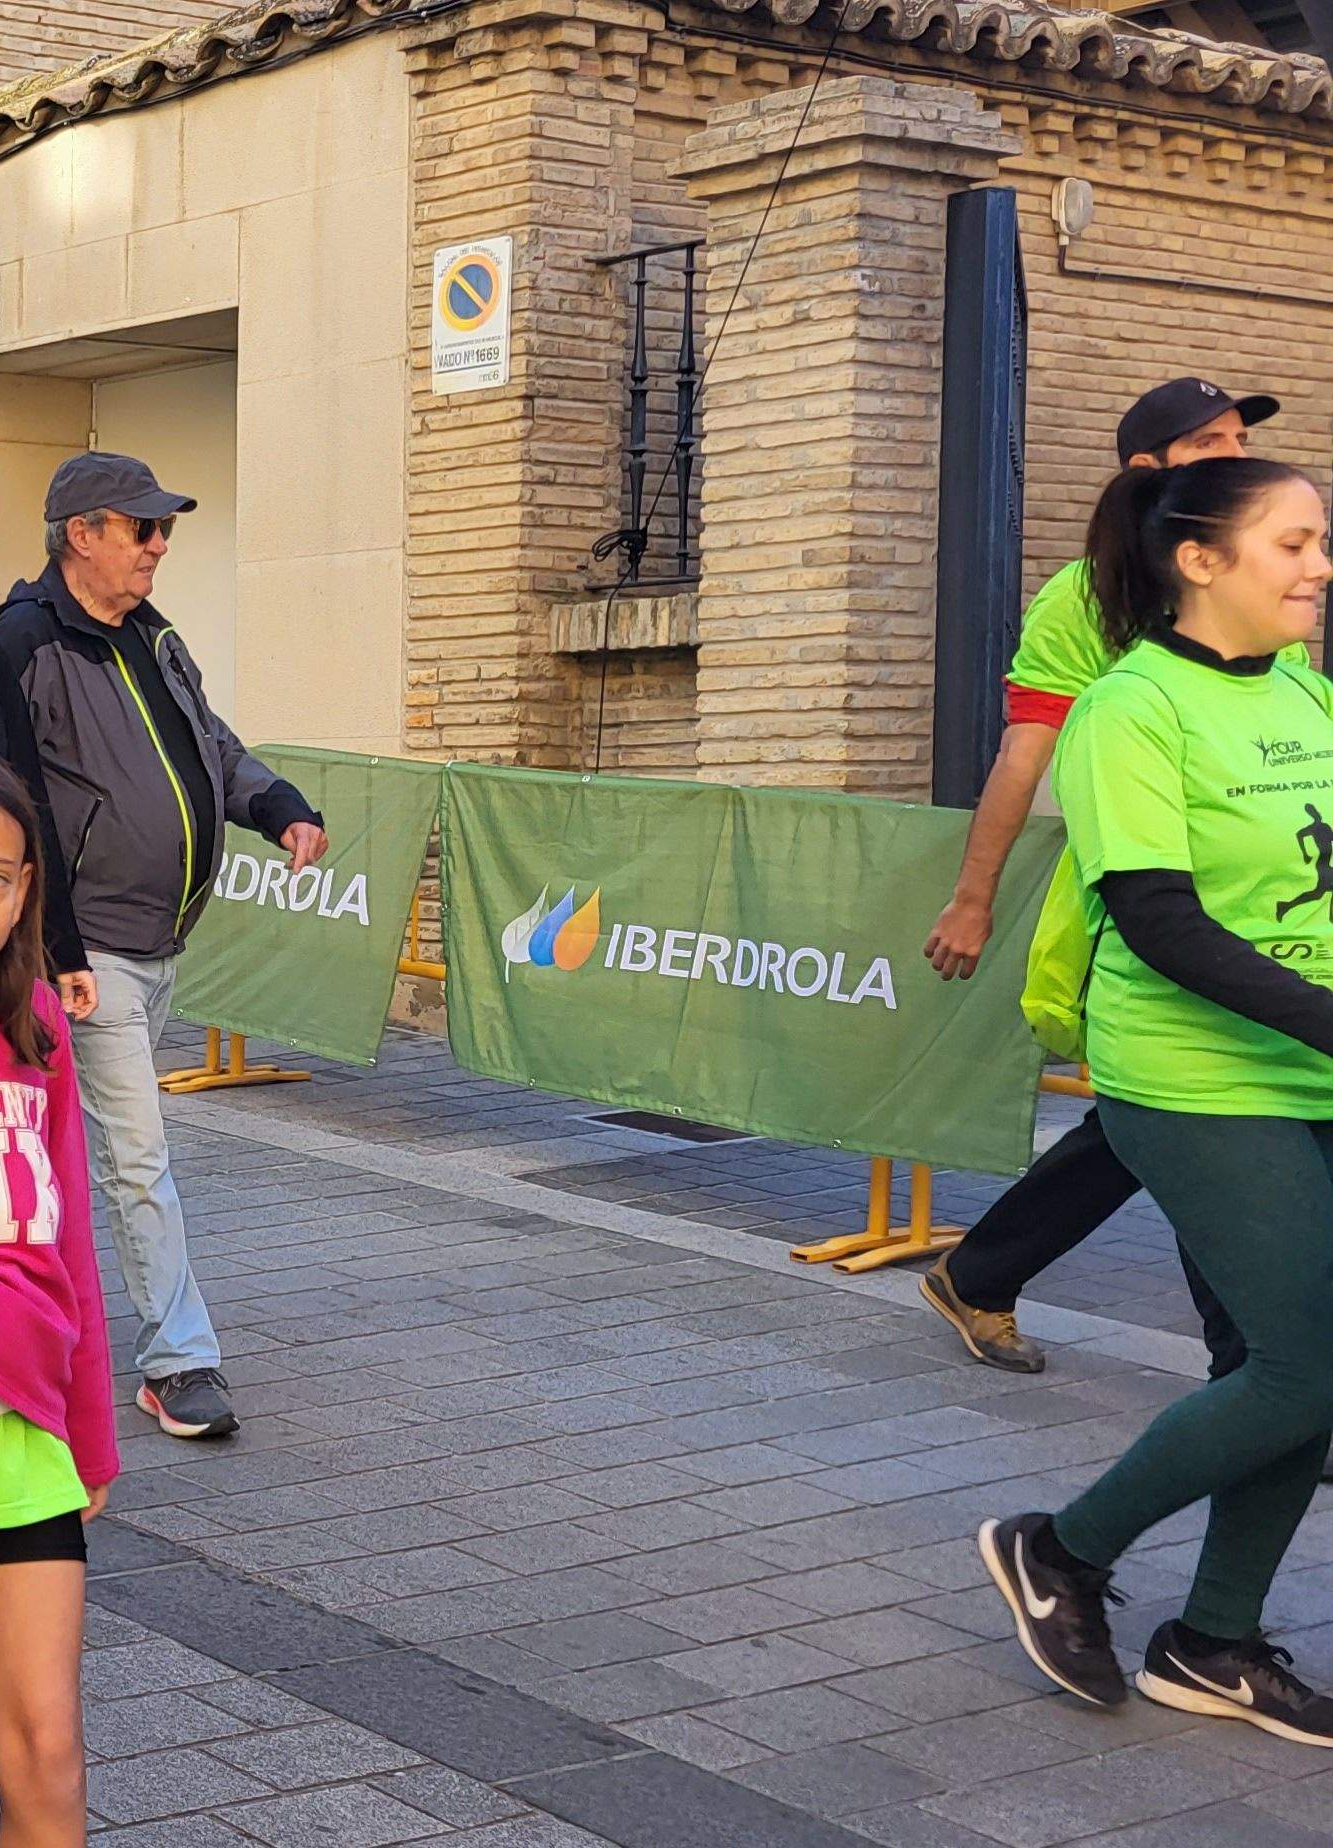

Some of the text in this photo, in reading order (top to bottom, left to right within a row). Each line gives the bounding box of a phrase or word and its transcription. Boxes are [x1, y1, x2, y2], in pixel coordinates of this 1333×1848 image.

[475, 346, 500, 362] 1669
[1226, 786, 1246, 798] EN
[1249, 782, 1291, 795] FORMA
[1291, 780, 1314, 791] POR
[213, 851, 371, 927] RDROLA
[603, 923, 898, 1010] IBERDROLA
